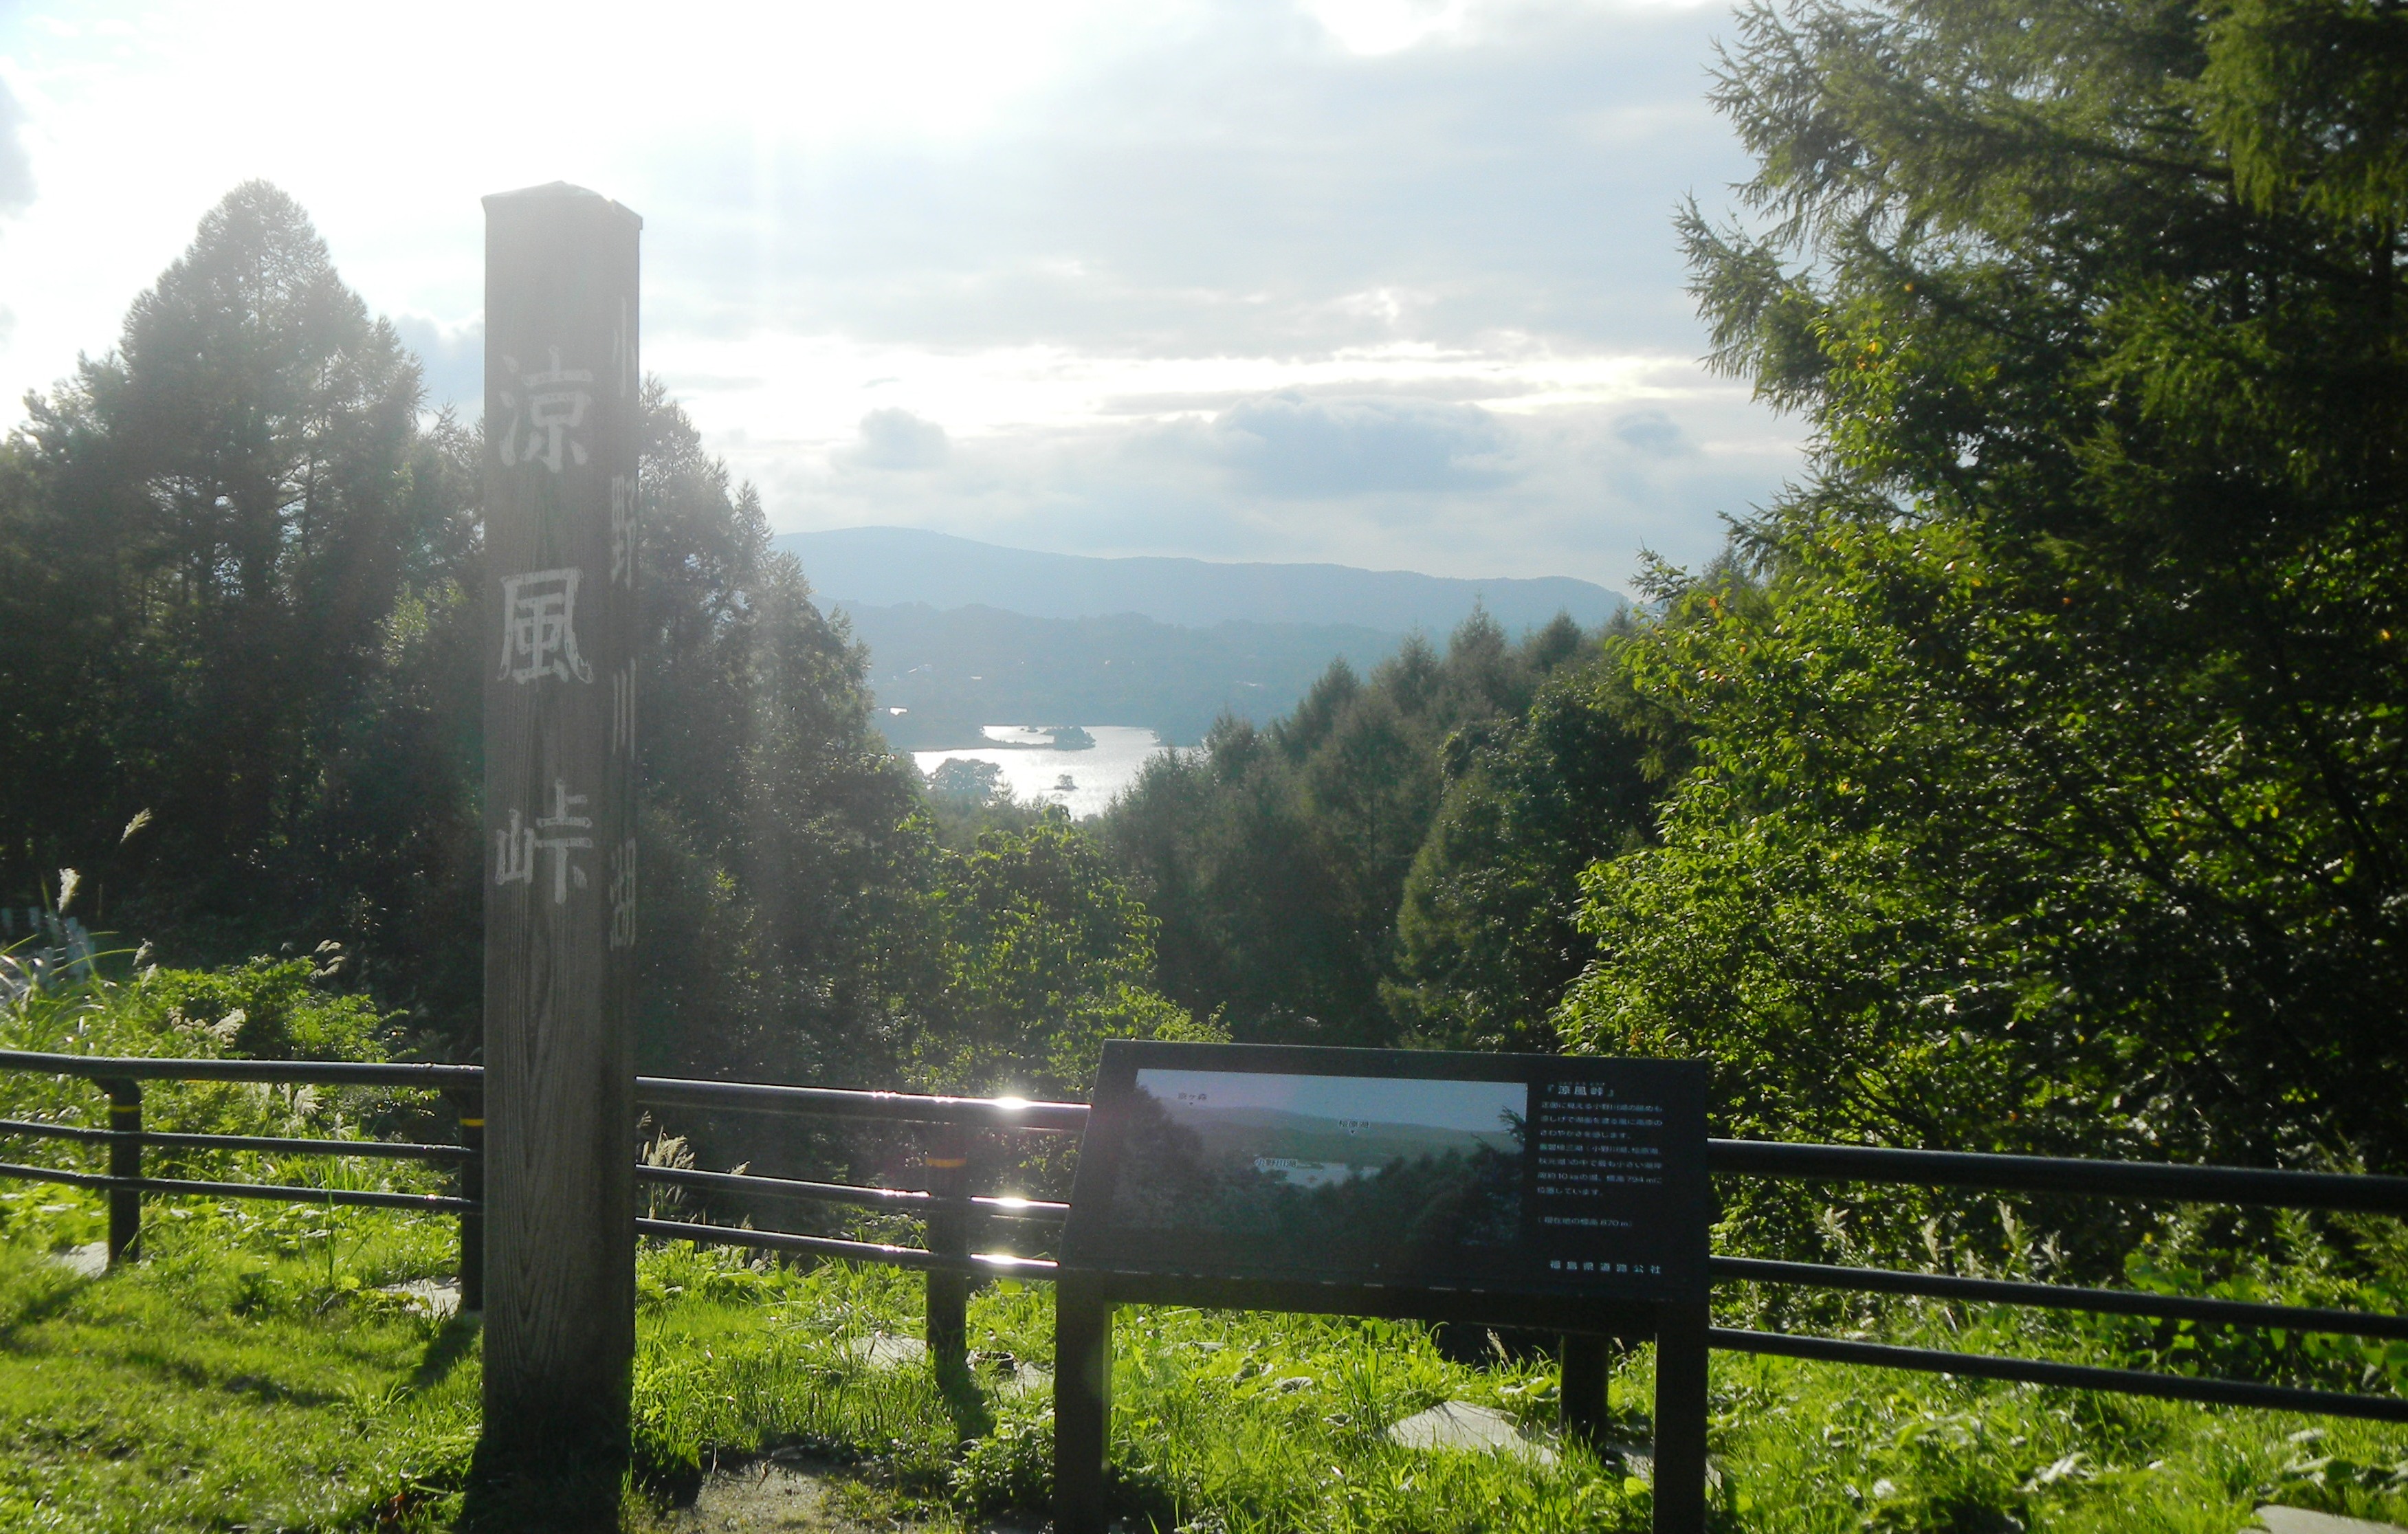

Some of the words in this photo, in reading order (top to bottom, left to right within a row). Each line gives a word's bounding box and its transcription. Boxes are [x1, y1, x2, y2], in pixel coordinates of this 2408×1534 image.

[496, 345, 594, 904] 涼風峠
[610, 295, 637, 952] 小野川湖
[1549, 1260, 1661, 1274] 福島県道路公社
